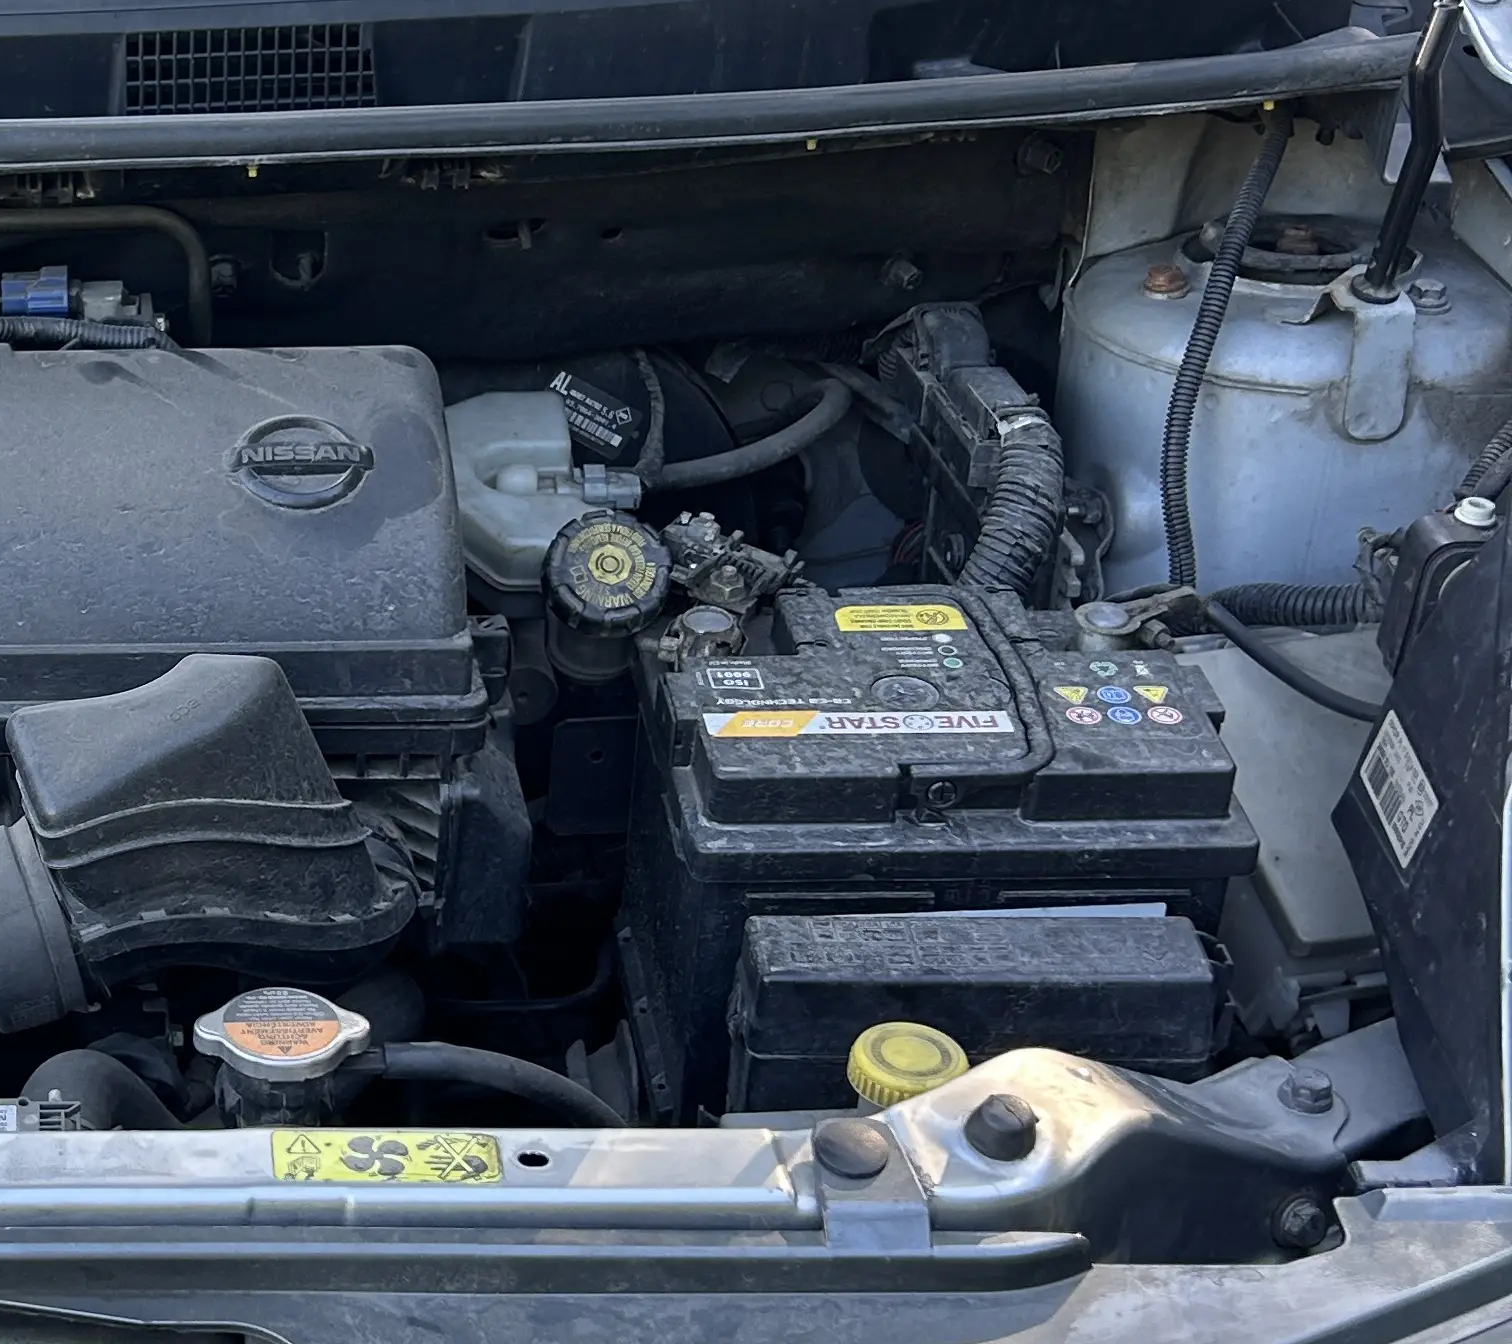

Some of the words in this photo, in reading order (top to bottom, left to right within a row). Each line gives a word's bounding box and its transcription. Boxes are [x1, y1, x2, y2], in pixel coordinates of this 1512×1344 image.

[550, 371, 572, 396] AL
[241, 445, 360, 464] NISSAN
[716, 697, 806, 706] TECHNOLOGY
[934, 714, 999, 729] FIVE
